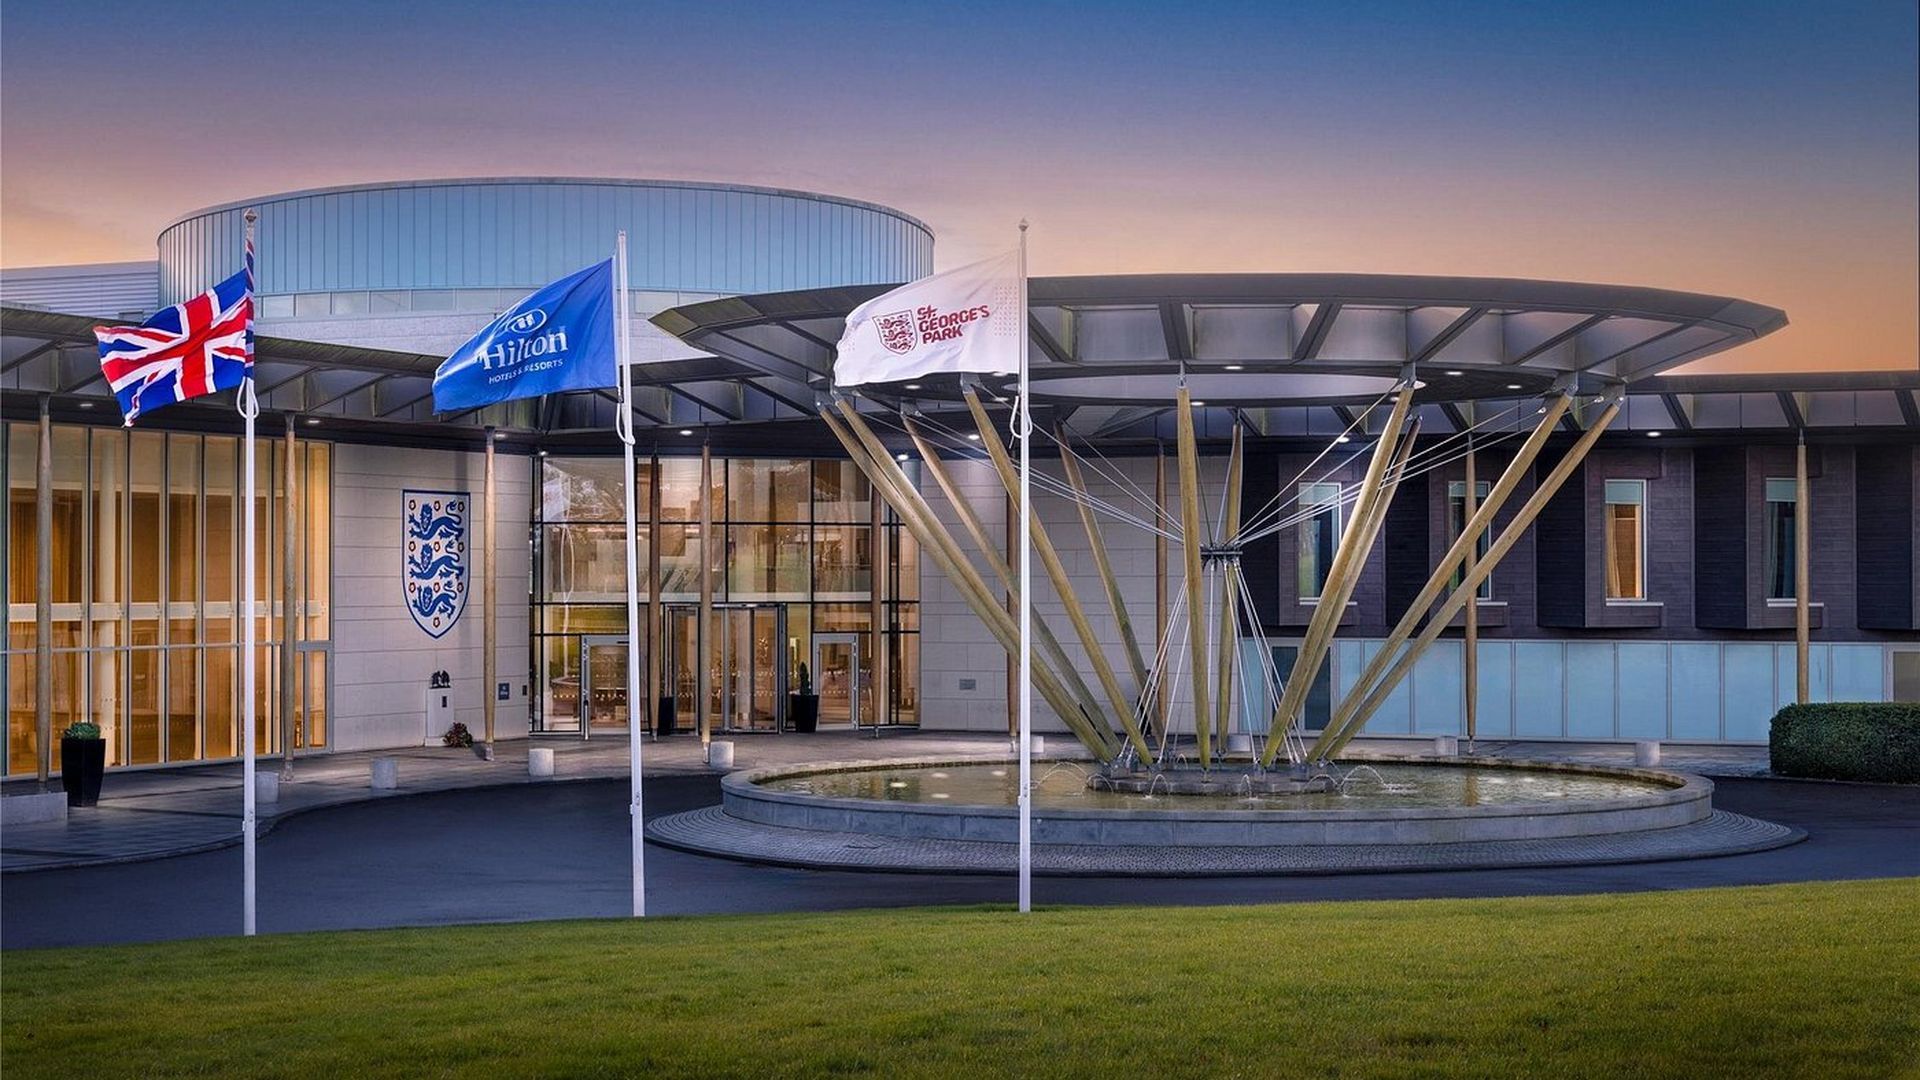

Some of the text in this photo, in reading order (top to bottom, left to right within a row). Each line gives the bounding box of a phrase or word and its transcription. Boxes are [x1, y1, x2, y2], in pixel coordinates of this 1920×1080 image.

[917, 305, 938, 320] St.
[919, 305, 990, 333] GEORGE'S
[922, 324, 963, 344] PARK
[480, 328, 568, 370] Hilton
[488, 370, 517, 384] HOTELS
[524, 359, 563, 372] RESORTS
